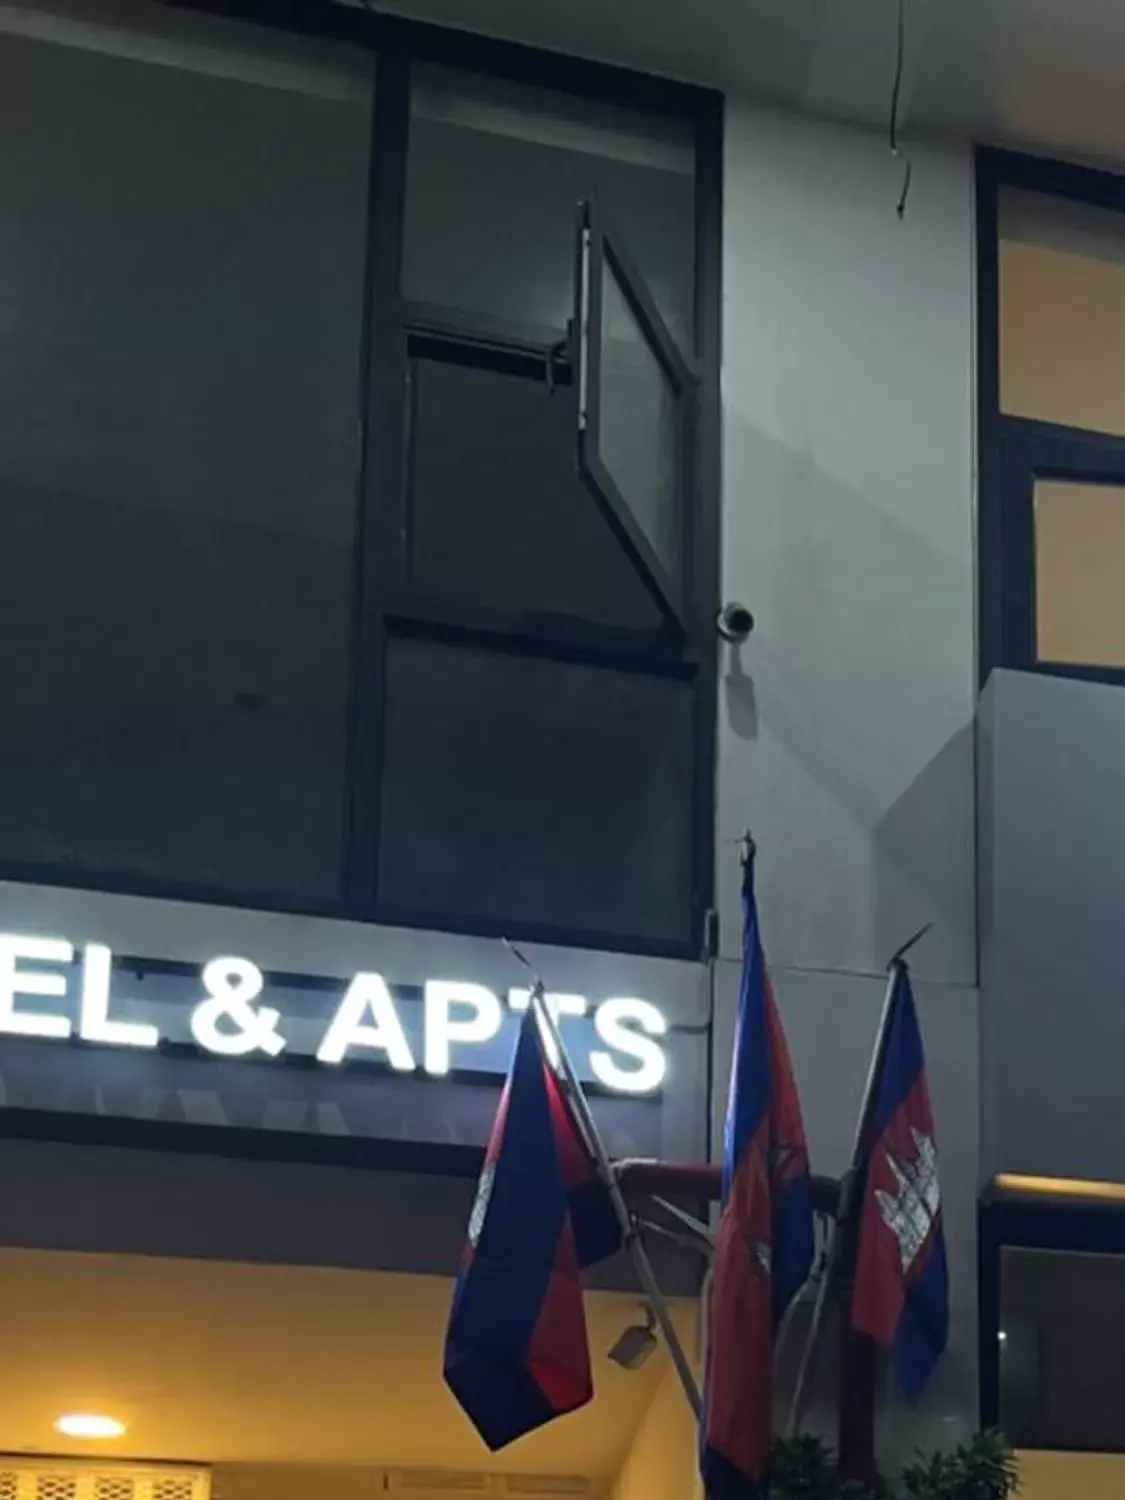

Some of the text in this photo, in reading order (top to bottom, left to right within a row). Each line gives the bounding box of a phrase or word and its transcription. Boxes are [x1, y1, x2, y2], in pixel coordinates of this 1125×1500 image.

[0, 934, 667, 1092] EL & APTS
